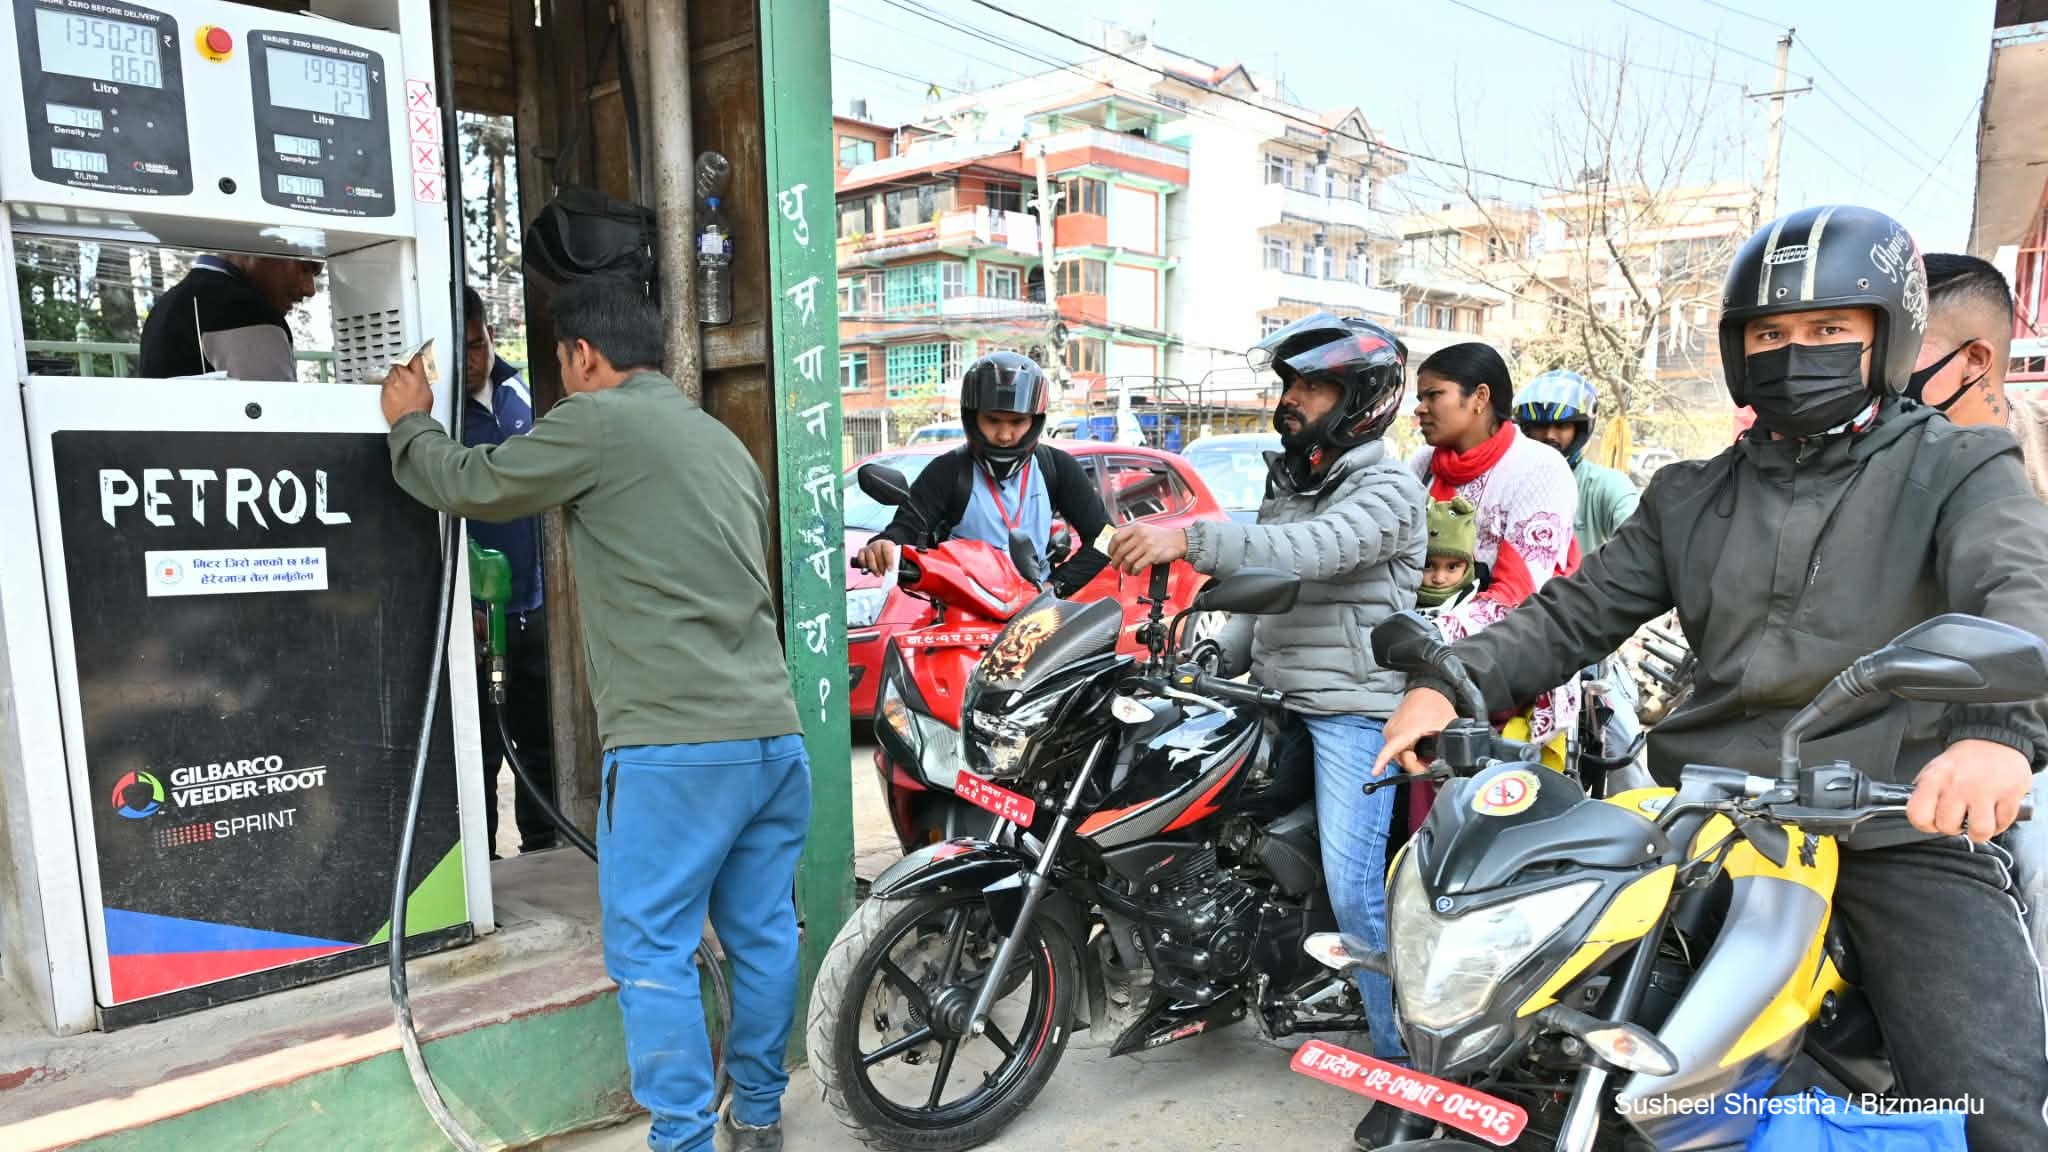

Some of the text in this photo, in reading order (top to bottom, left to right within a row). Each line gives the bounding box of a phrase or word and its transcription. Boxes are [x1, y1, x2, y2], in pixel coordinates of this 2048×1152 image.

[68, 0, 89, 9] ZERO
[91, 4, 122, 16] BEFORE
[124, 11, 160, 22] DELIVERY
[65, 17, 154, 56] 1350.20
[262, 34, 369, 59] ENSURE ZERO BEFORE DELIVERY
[92, 82, 119, 95] Litre
[312, 114, 335, 126] Litre
[54, 126, 85, 138] Density
[280, 154, 306, 165] Density
[99, 468, 352, 530] PETROL
[193, 558, 221, 569] मिटर
[224, 557, 249, 568] जिरो
[253, 556, 283, 567] भएको
[250, 572, 269, 582] तेल
[172, 754, 283, 785] GILBARCO
[172, 769, 327, 809] VEEDER-ROOT
[214, 808, 297, 839] SPRINT
